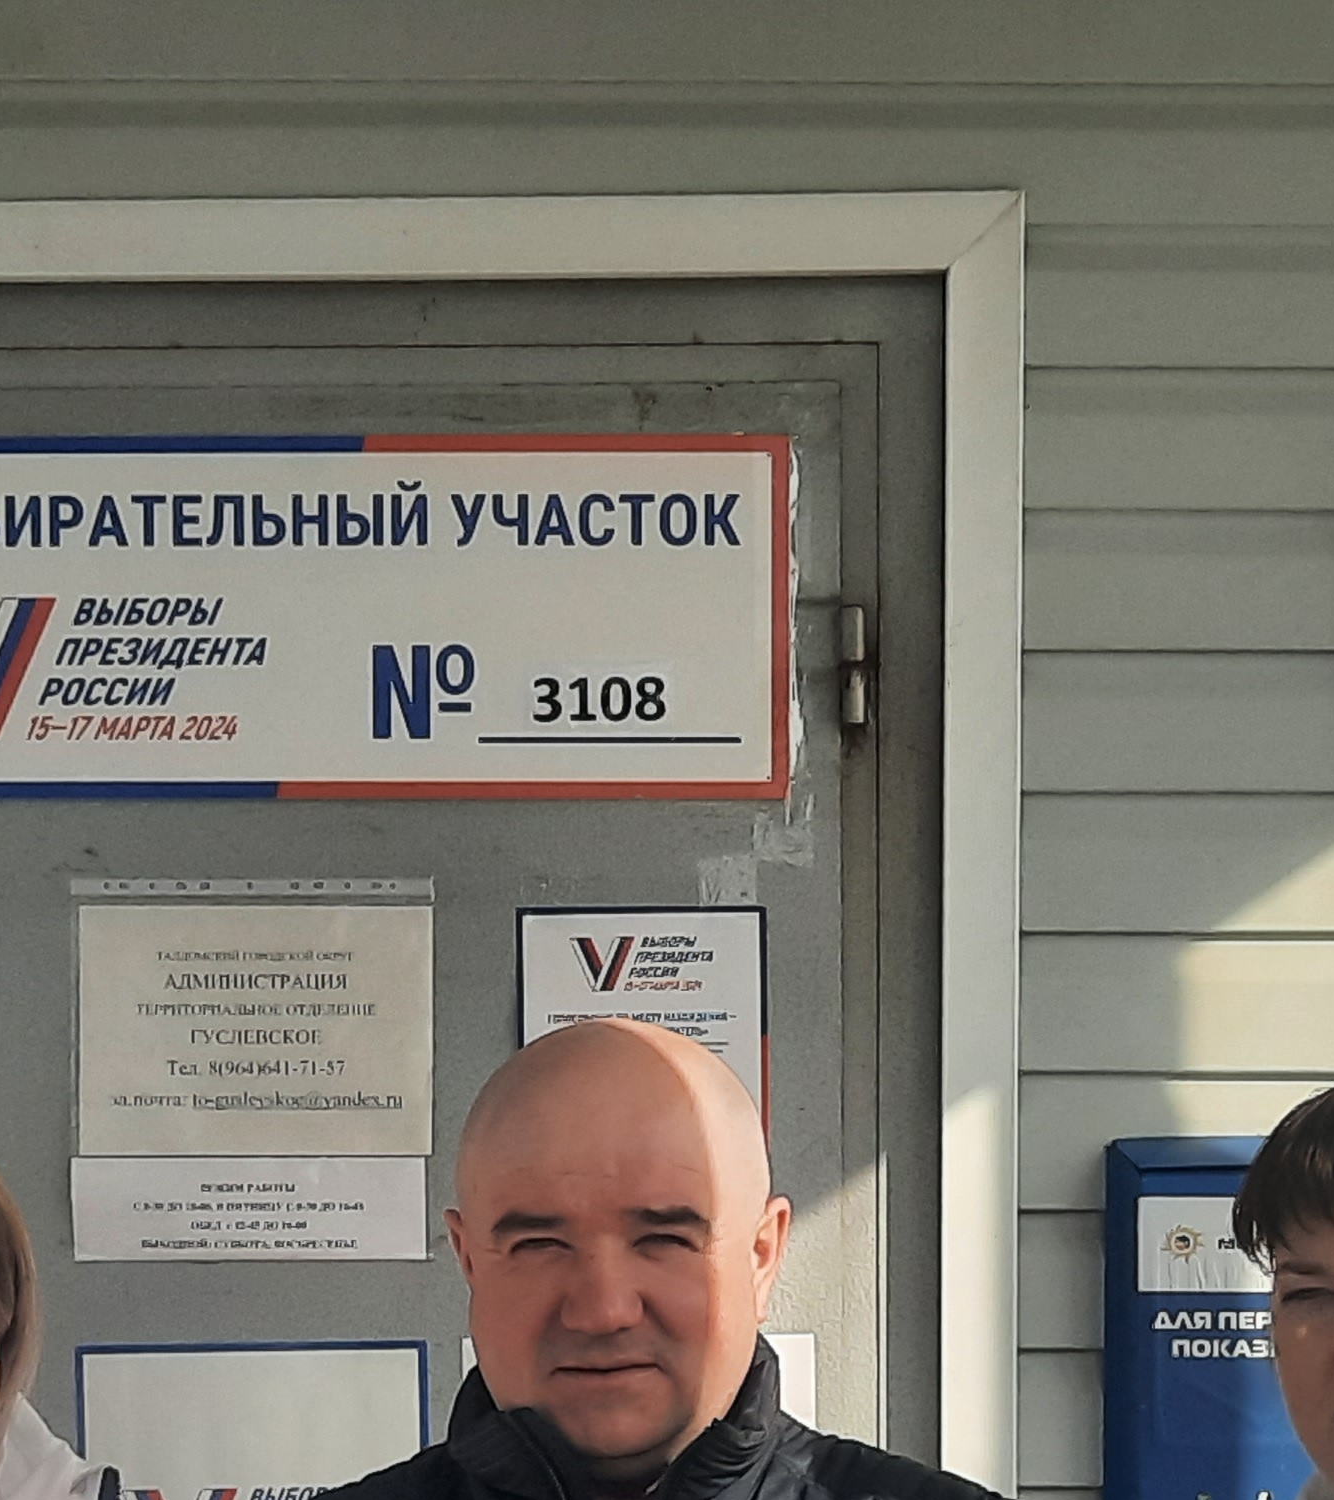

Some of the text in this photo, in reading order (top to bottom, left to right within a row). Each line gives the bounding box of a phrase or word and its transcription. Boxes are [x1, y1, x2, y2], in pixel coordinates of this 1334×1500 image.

[456, 493, 742, 547] УЧАСТОК
[73, 598, 224, 626] ВЫБОРЫ
[55, 637, 268, 669] ПРЕЗИДЕНТА
[38, 677, 176, 706] РОССИИ
[532, 676, 666, 722] 3108
[94, 715, 175, 741] МАРТА
[179, 715, 238, 741] 2024
[164, 974, 347, 991] АДМИНИСТРАЦИЯ
[137, 1004, 375, 1017] ТЕРРИТОРИАЛЬНОЕ ОТДЕЛЕНИЕ
[190, 1029, 322, 1045] ГУСЛЕВСКОЕ
[167, 1060, 200, 1076] Тел.
[1152, 1311, 1212, 1330] ДЛЯ
[1171, 1338, 1276, 1358] ПОКАЗ
